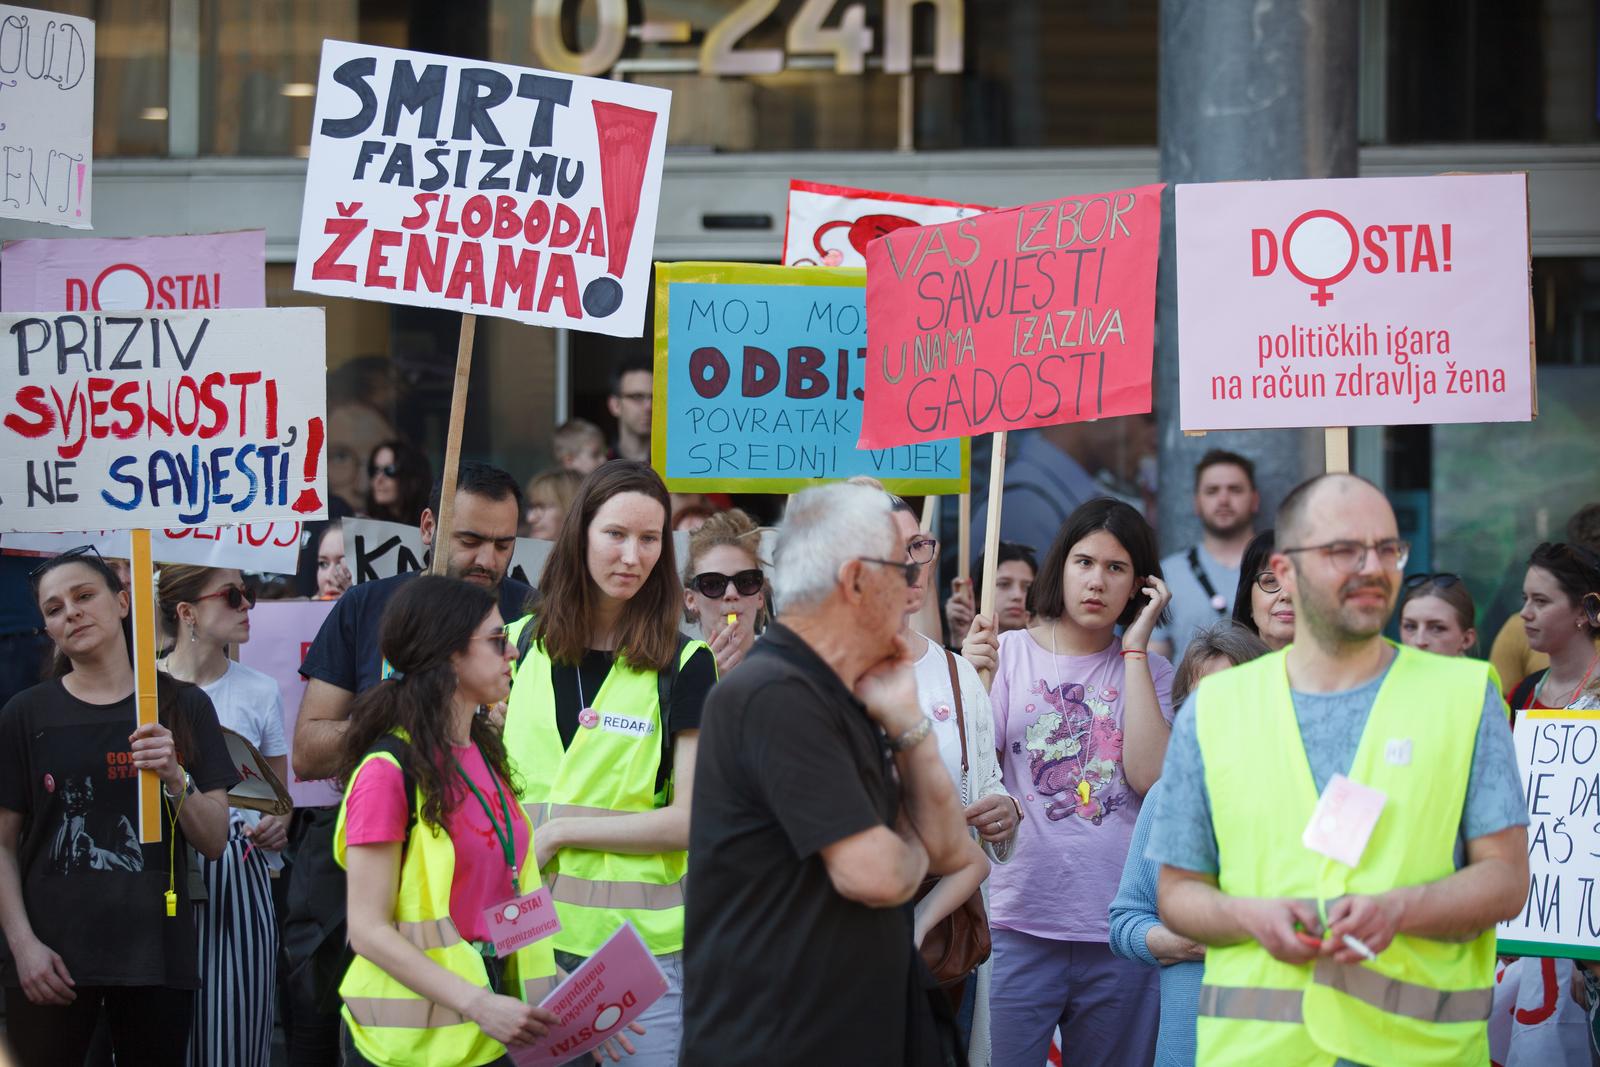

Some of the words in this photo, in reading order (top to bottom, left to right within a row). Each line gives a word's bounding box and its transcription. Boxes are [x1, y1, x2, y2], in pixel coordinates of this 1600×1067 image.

[320, 57, 574, 147] SMRT
[352, 140, 584, 199] FAŠIZMU
[401, 193, 607, 257] SLOBODA
[1015, 193, 1136, 253] IZBOR
[1251, 209, 1452, 307] DOSTA!
[916, 247, 1106, 332] SAVJESTI
[688, 299, 770, 335] MOJ
[806, 301, 867, 335] MO
[1012, 307, 1126, 357] IZAZIVA
[9, 315, 210, 376] PRIZIV
[1258, 323, 1378, 368] političkih
[1386, 326, 1451, 365] igara
[906, 351, 1105, 433] GADOSTI
[1211, 374, 1243, 400] na
[1252, 366, 1326, 400] račun
[1335, 363, 1437, 404] zdravlja
[1446, 361, 1506, 395] žena
[685, 407, 851, 435] POVRATAK
[27, 460, 79, 507] NE
[688, 443, 837, 479] SREDNJI
[870, 444, 952, 473] VIJEK
[1530, 723, 1598, 766] ISTO
[494, 895, 543, 925] DOSTA!
[1525, 873, 1560, 934] NA
[496, 919, 557, 949] organizatorica
[549, 990, 637, 1057] DOSTA!
